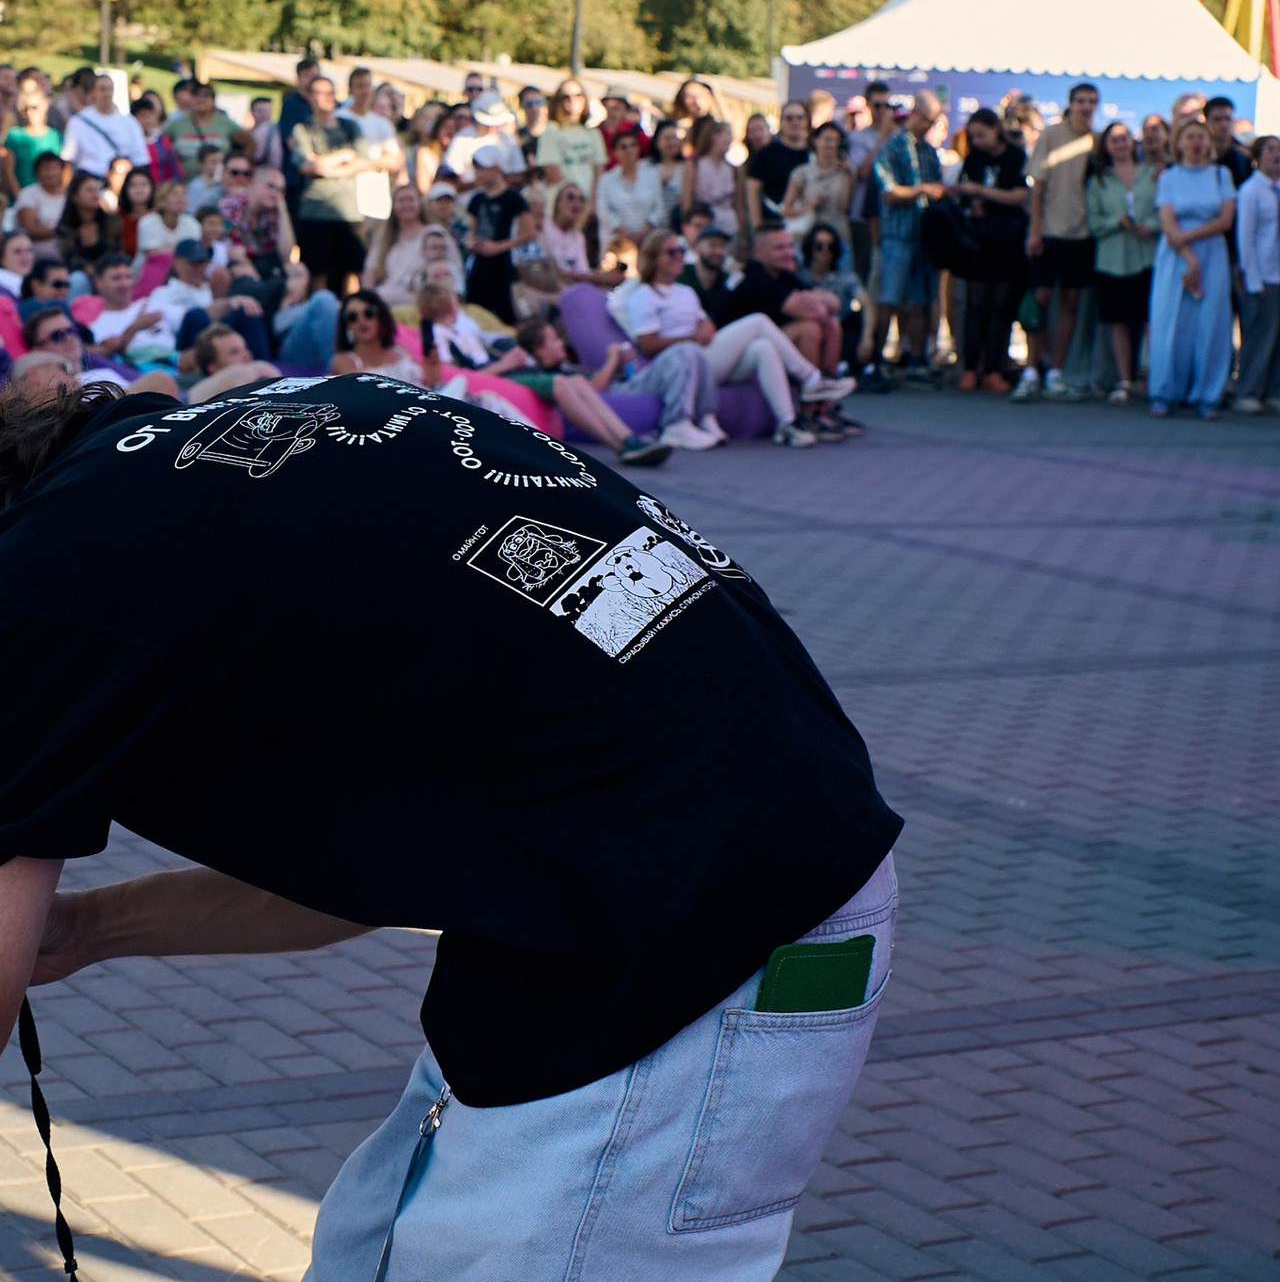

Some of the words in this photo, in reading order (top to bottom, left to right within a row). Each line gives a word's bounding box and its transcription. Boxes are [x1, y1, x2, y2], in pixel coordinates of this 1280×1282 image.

[116, 425, 172, 453] ОТ
[452, 553, 461, 561] О
[457, 534, 479, 556] МАЙН
[474, 524, 489, 539] ГОТ
